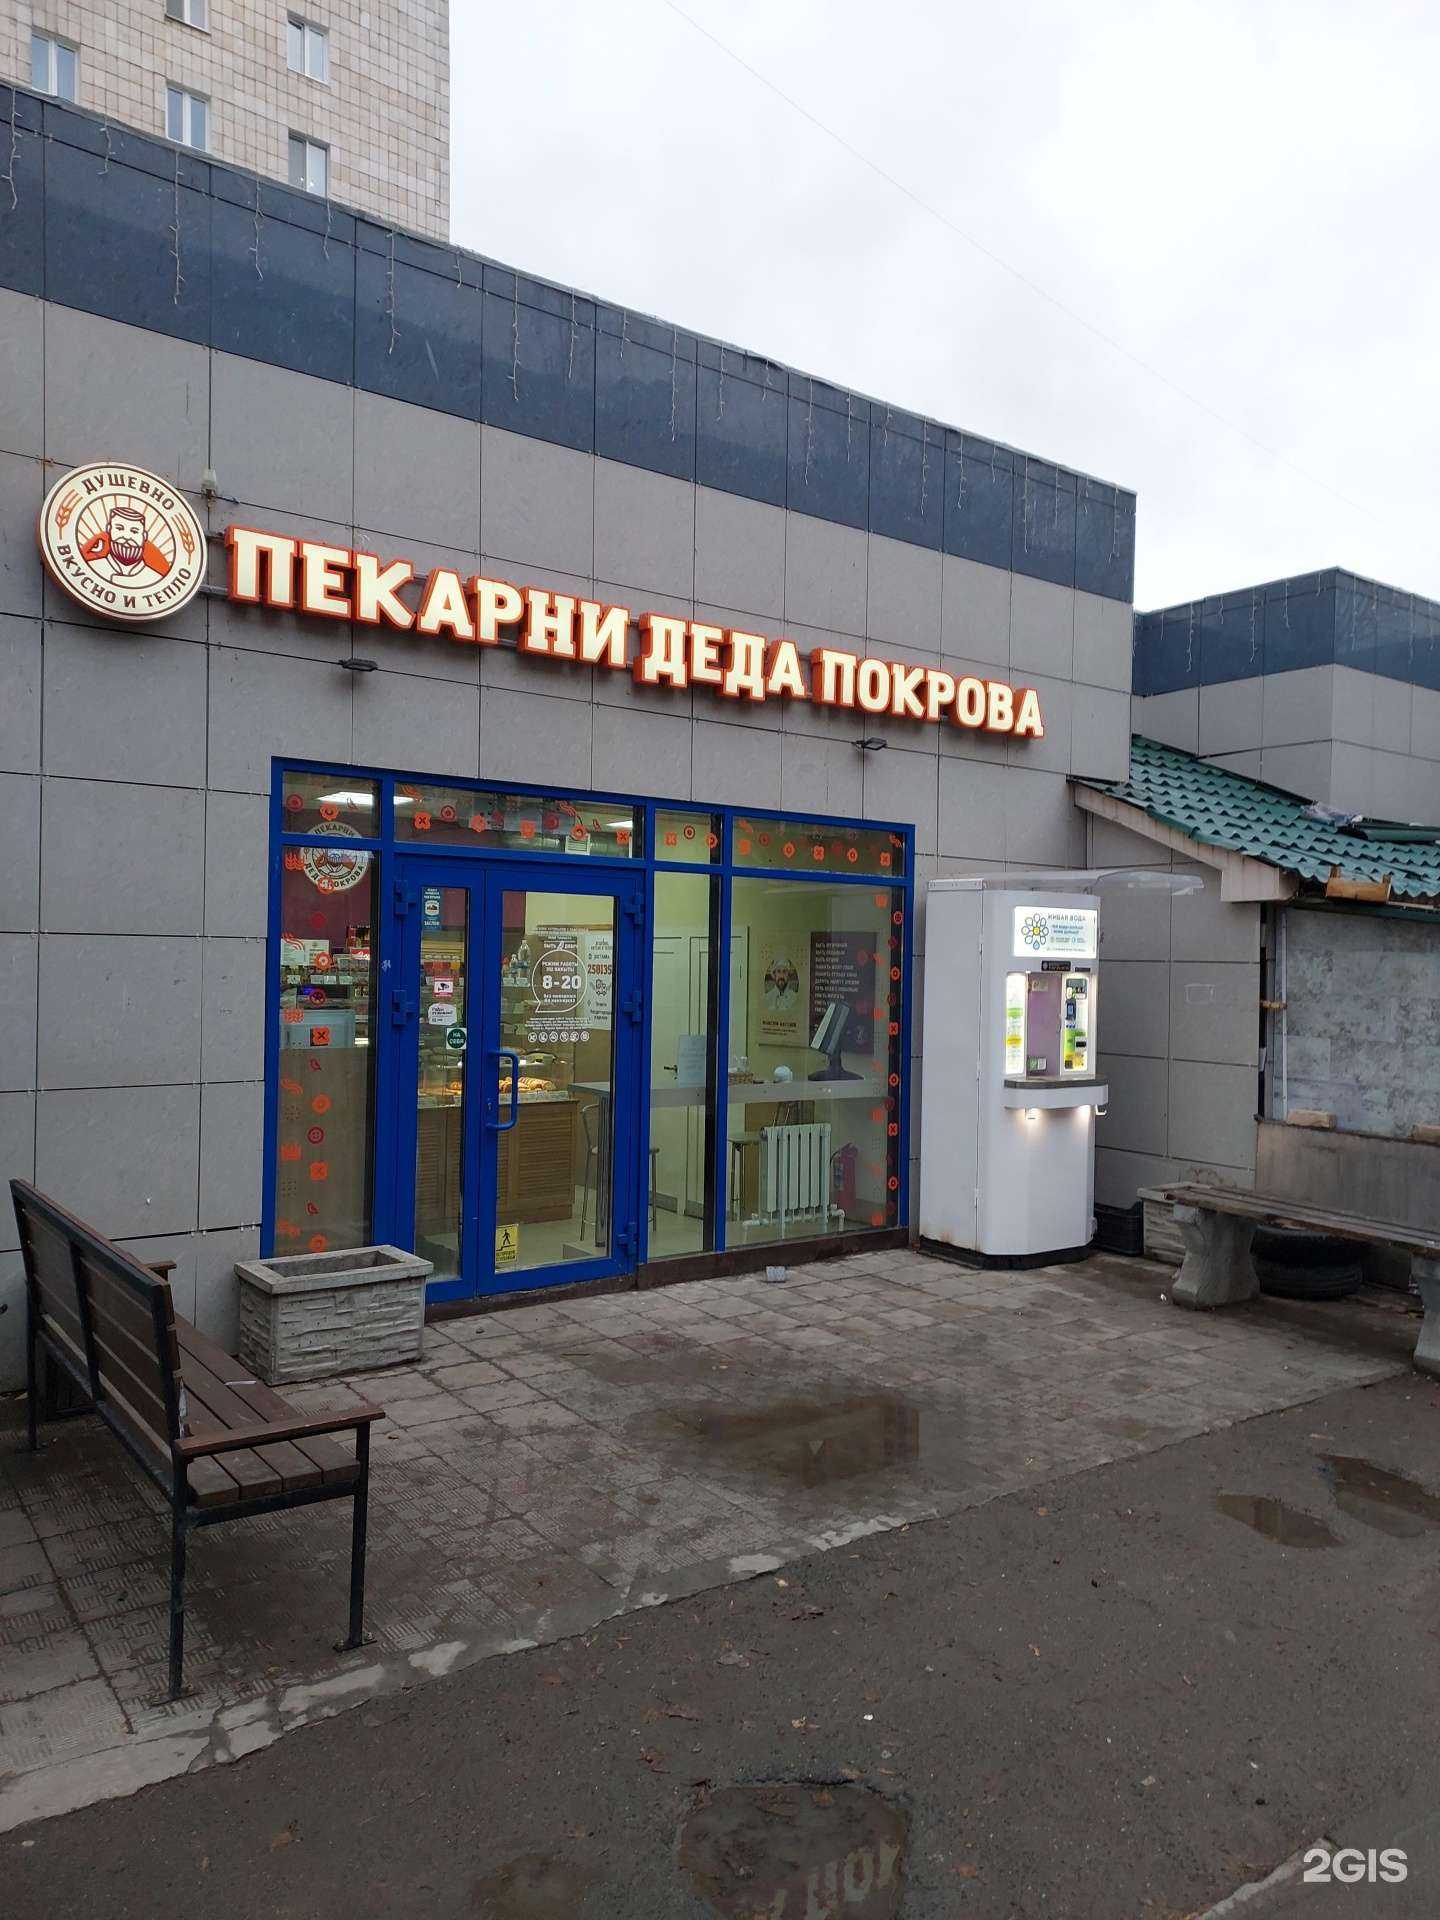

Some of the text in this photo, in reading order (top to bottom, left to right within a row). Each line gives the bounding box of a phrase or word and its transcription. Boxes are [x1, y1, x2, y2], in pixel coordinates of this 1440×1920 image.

[81, 473, 175, 511] ДУШЕВНО
[57, 544, 192, 609] ВКУСНО И ТЕПЛО
[229, 525, 1044, 737] ПЕКАРНИ ДЕДА ПОКРОВА
[333, 865, 364, 887] ОКРОВА
